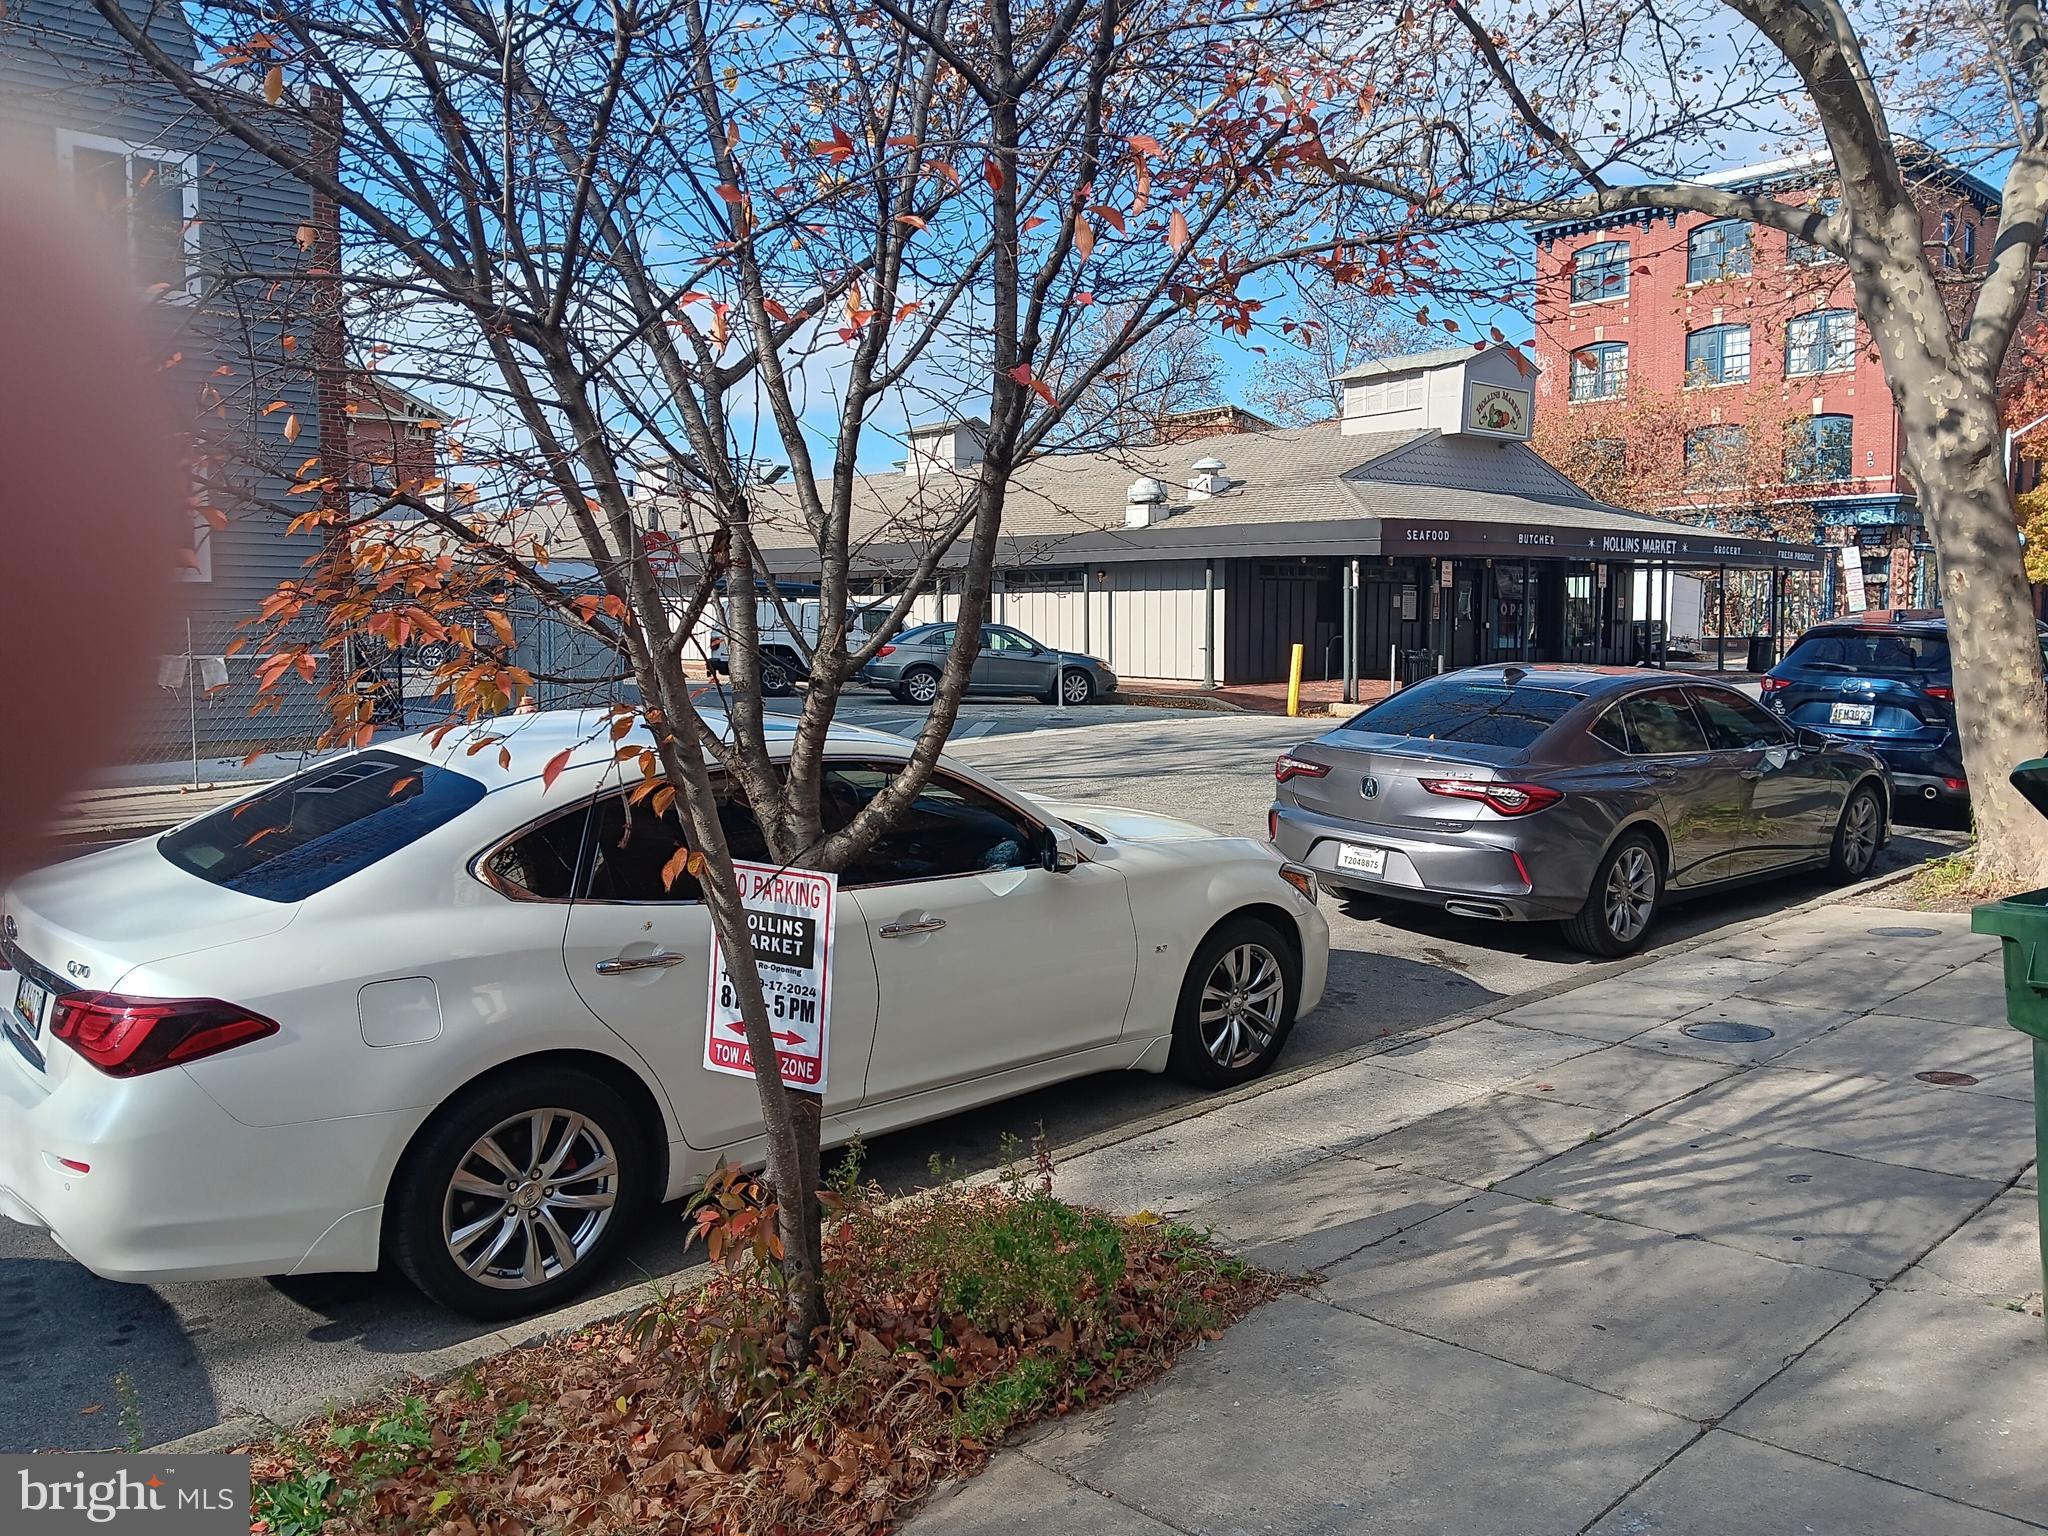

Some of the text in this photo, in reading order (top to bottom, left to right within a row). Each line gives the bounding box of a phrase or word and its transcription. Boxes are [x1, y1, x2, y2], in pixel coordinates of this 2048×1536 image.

[1406, 529, 1450, 541] SEAFOOD
[1518, 533, 1555, 545] BUTCHER
[1602, 536, 1677, 555] HOLLINS MARKET
[1713, 545, 1741, 556] GROCERY
[1777, 550, 1816, 562] FRESH PRODUCE
[754, 875, 821, 909] PARKING
[747, 914, 804, 937] OLLINS
[750, 933, 804, 956] ARKET
[66, 960, 91, 978] Q70
[758, 962, 803, 978] Re-Opening
[774, 994, 785, 1018] 5
[788, 997, 816, 1024] PM
[715, 1043, 739, 1064] TOW
[781, 1057, 815, 1079] ZONE
